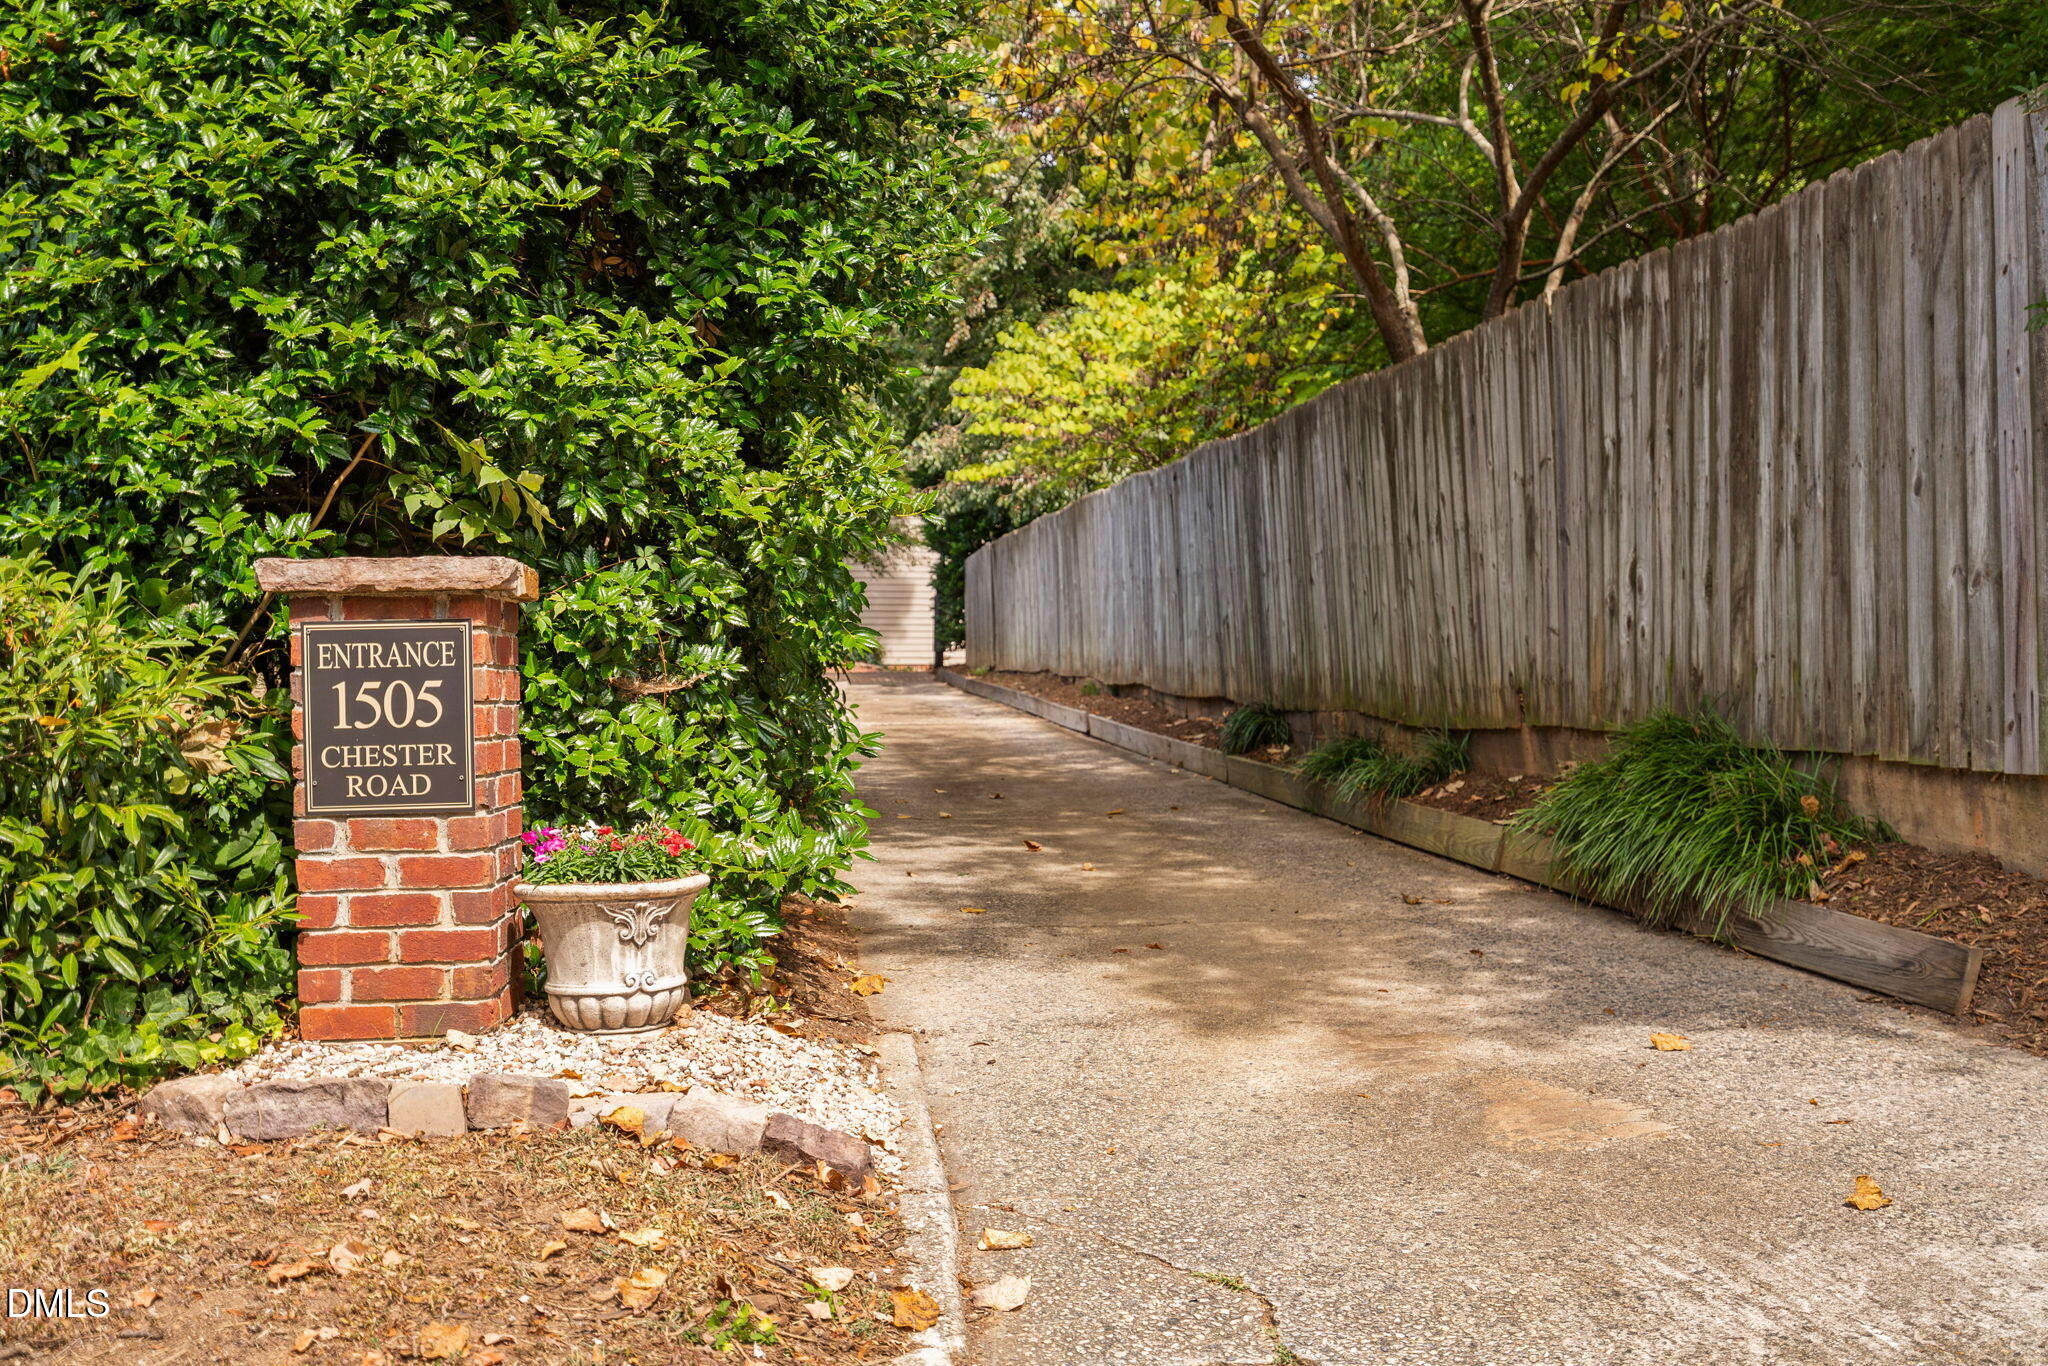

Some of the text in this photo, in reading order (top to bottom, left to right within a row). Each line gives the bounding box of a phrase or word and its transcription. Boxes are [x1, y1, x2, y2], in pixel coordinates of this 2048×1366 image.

[317, 641, 457, 669] ENTRANCE
[331, 679, 443, 730] 1505
[321, 743, 457, 769] CHESTER
[346, 773, 432, 798] ROAD
